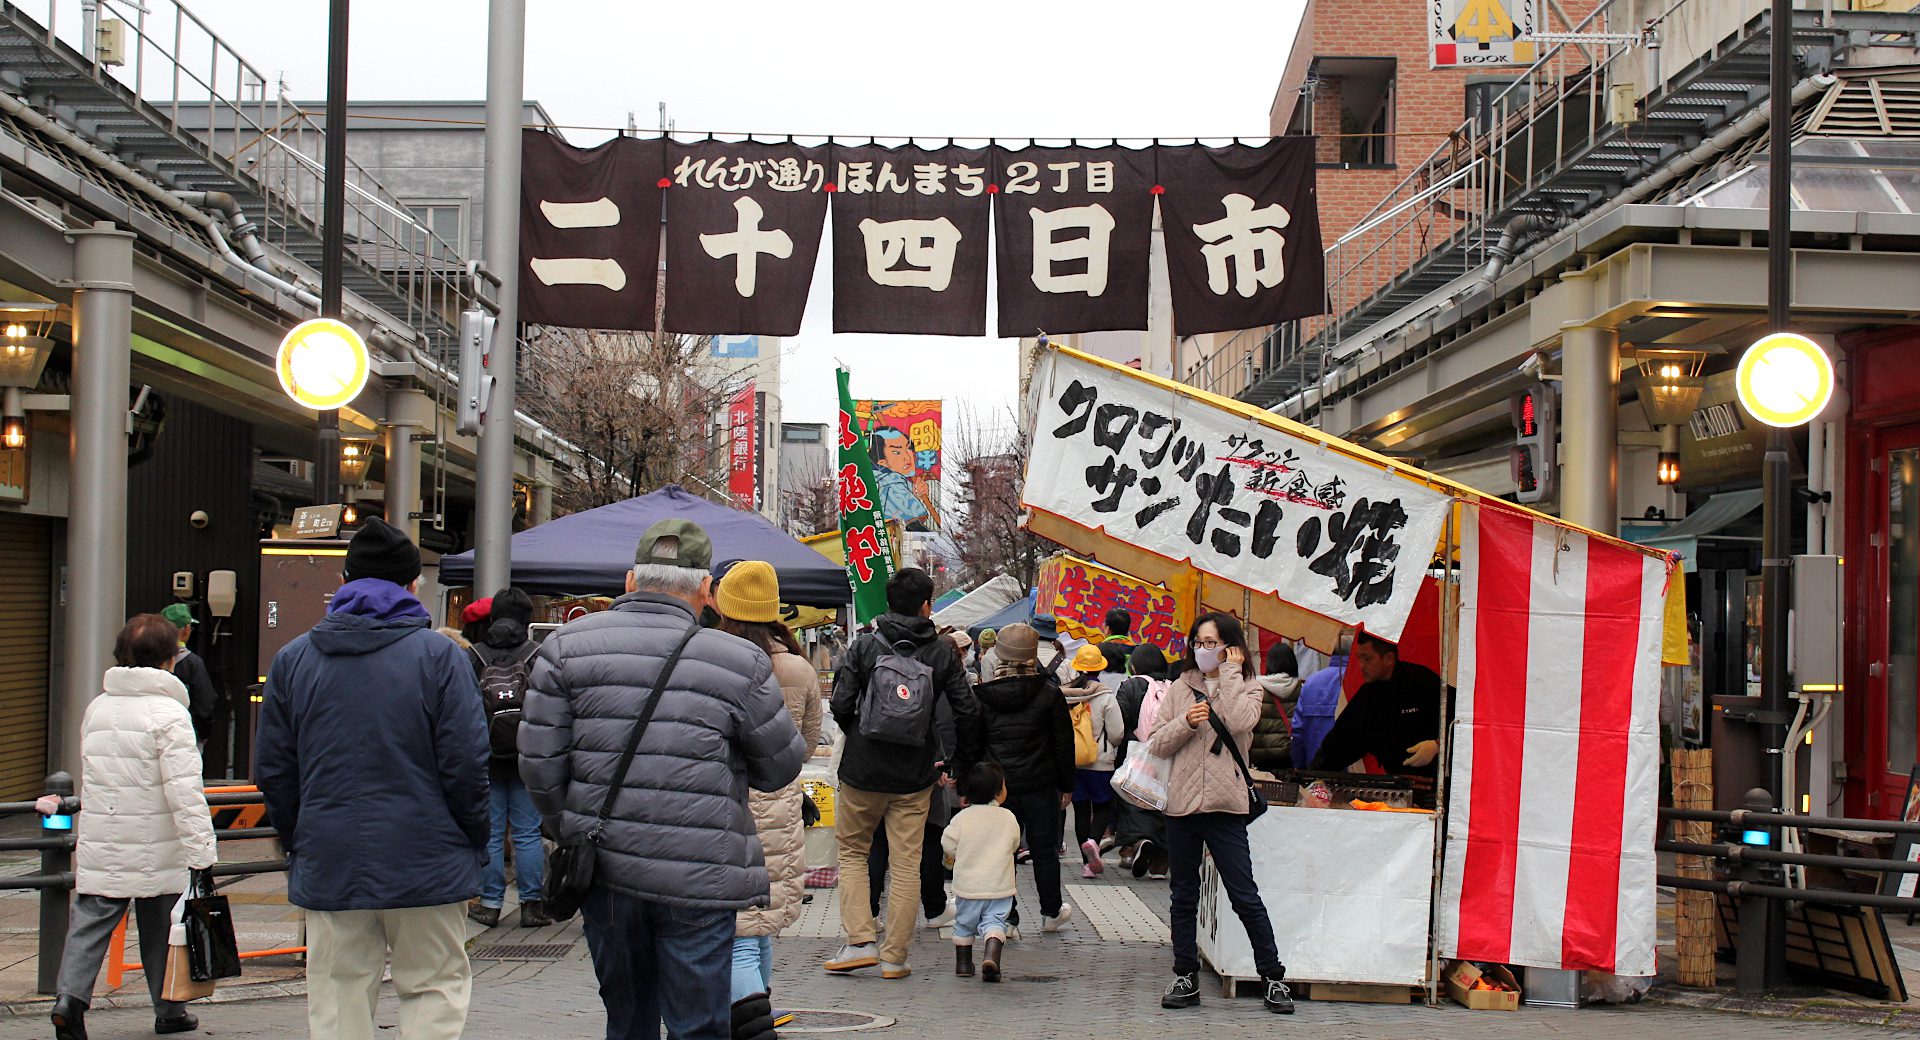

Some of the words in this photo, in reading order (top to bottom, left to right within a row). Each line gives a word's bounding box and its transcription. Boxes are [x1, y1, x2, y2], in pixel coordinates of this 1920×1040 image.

[1434, 0, 1443, 39] OOK
[1463, 55, 1509, 64] BOOK
[674, 156, 824, 193] れんが通り
[733, 410, 749, 471] 北陸銀行
[1690, 410, 1708, 441] LE
[1702, 404, 1737, 438] MIDI
[1221, 432, 1300, 471] サクッと
[1245, 465, 1347, 510] 新食感
